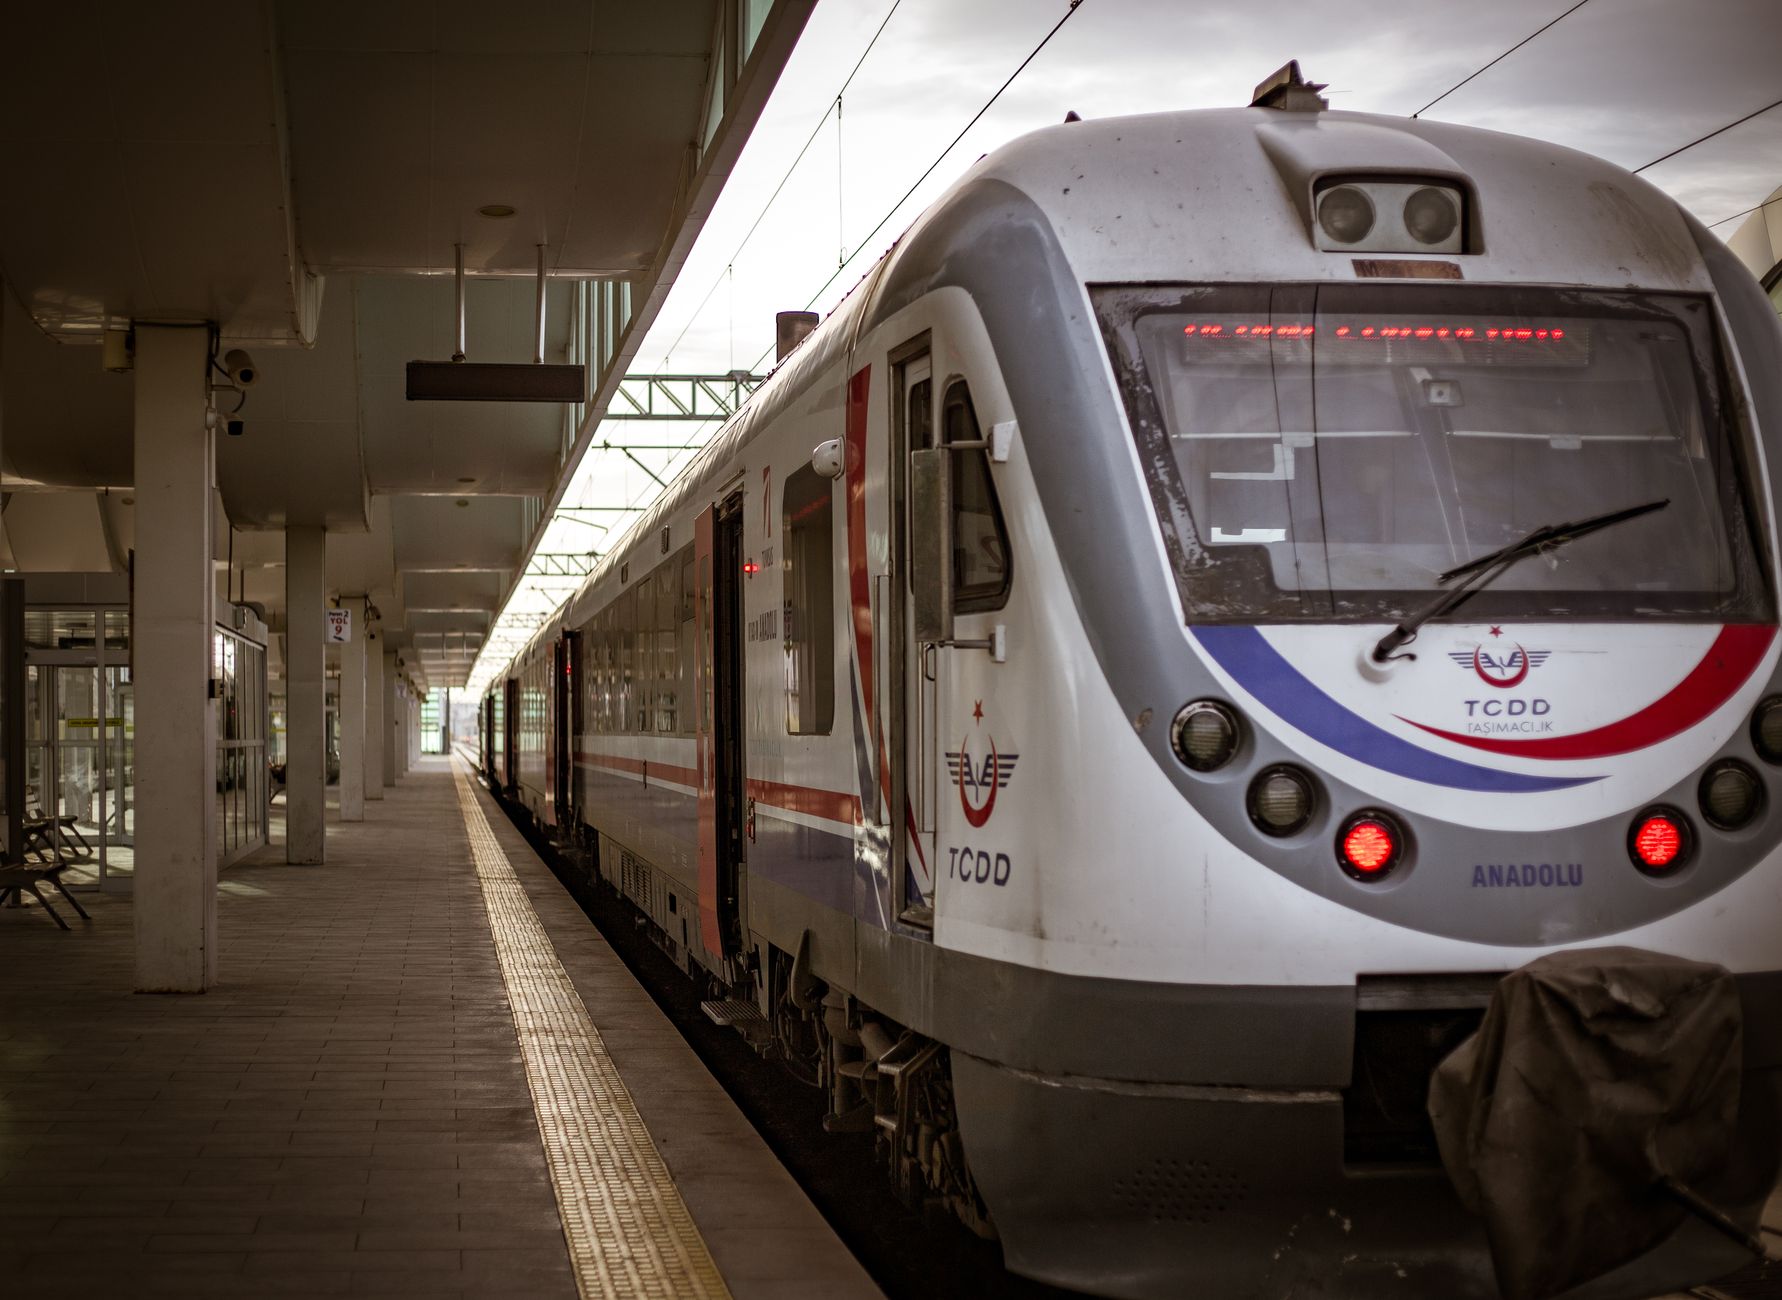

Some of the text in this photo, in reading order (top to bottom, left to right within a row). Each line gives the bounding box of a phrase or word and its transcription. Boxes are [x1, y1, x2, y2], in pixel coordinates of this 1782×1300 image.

[335, 625, 342, 635] 9
[1464, 699, 1551, 717] TCDD
[949, 846, 1011, 887] TCDD
[1472, 864, 1584, 887] ANADOLU
